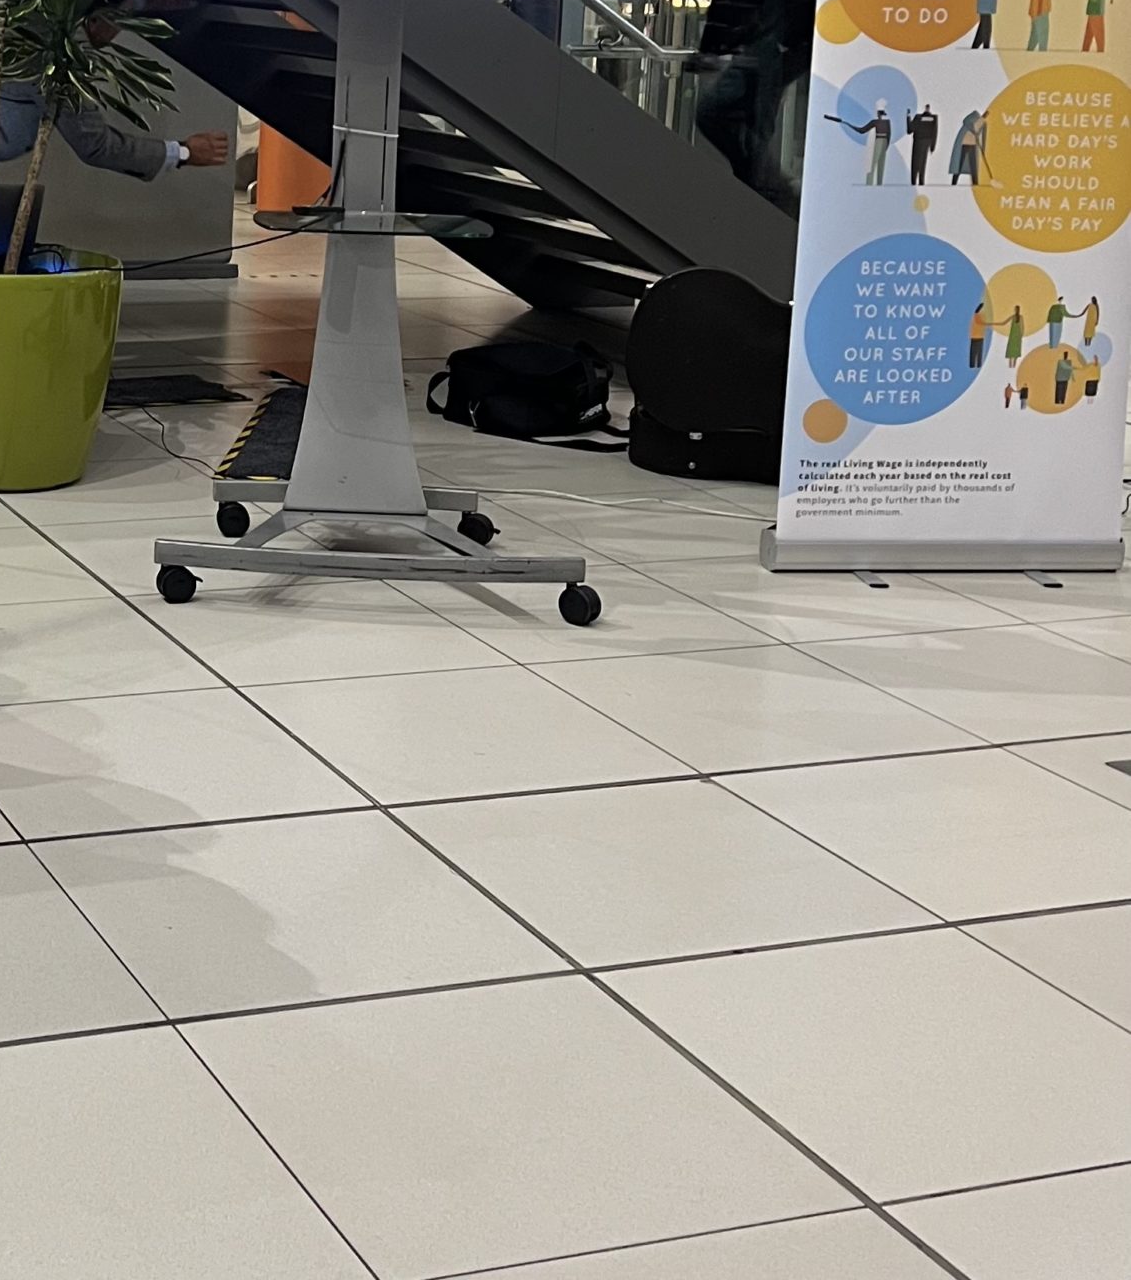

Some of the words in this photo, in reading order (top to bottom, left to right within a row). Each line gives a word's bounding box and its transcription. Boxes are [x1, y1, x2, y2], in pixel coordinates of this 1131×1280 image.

[882, 7, 910, 24] TO
[919, 7, 949, 24] DO
[1025, 91, 1113, 108] BECAUSE
[1001, 111, 1031, 127] WE
[1038, 112, 1115, 128] BELIEVE
[1010, 133, 1060, 148] HARD
[1068, 134, 1118, 149] DAY'S
[1034, 154, 1093, 169] WORK
[1021, 174, 1100, 191] SHOULD
[1000, 195, 1051, 210] MEAN
[1059, 197, 1070, 211] A
[1077, 196, 1116, 211] FAIR
[1012, 216, 1063, 231] DAY'S
[1070, 217, 1103, 232] PAY
[860, 260, 947, 276] BECAUSE
[855, 282, 886, 297] WE
[893, 282, 947, 297] WANT
[853, 304, 878, 319] TO
[885, 304, 947, 319] KNOW
[864, 325, 897, 340] ALL
[904, 325, 931, 340] OF
[844, 347, 884, 362] OUR
[891, 346, 948, 361] STAFF
[834, 368, 869, 383] ARE
[876, 368, 953, 383] LOOKED
[862, 389, 921, 405] AFTER
[799, 460, 819, 468] The
[821, 459, 841, 468] real
[843, 459, 874, 469] Living
[876, 460, 903, 469] Wage
[905, 459, 913, 468] is
[915, 459, 988, 470] independently
[798, 471, 851, 480] calculated
[853, 471, 877, 480] each
[879, 472, 902, 481] year
[903, 471, 932, 480] based
[934, 472, 947, 480] on
[949, 471, 967, 480] the
[969, 471, 989, 480] real
[991, 472, 1012, 480] cost
[797, 483, 809, 492] of
[862, 483, 914, 494] voluntarily
[915, 483, 937, 493] paid
[939, 483, 951, 494] by
[953, 483, 1003, 492] thousands
[1004, 483, 1016, 492] of
[796, 497, 847, 506] employers
[849, 496, 869, 504] who
[871, 497, 884, 506] go
[885, 495, 918, 504] further
[920, 496, 942, 504] than
[944, 496, 961, 504] the
[795, 508, 853, 518] government
[855, 508, 903, 516] minimum.
